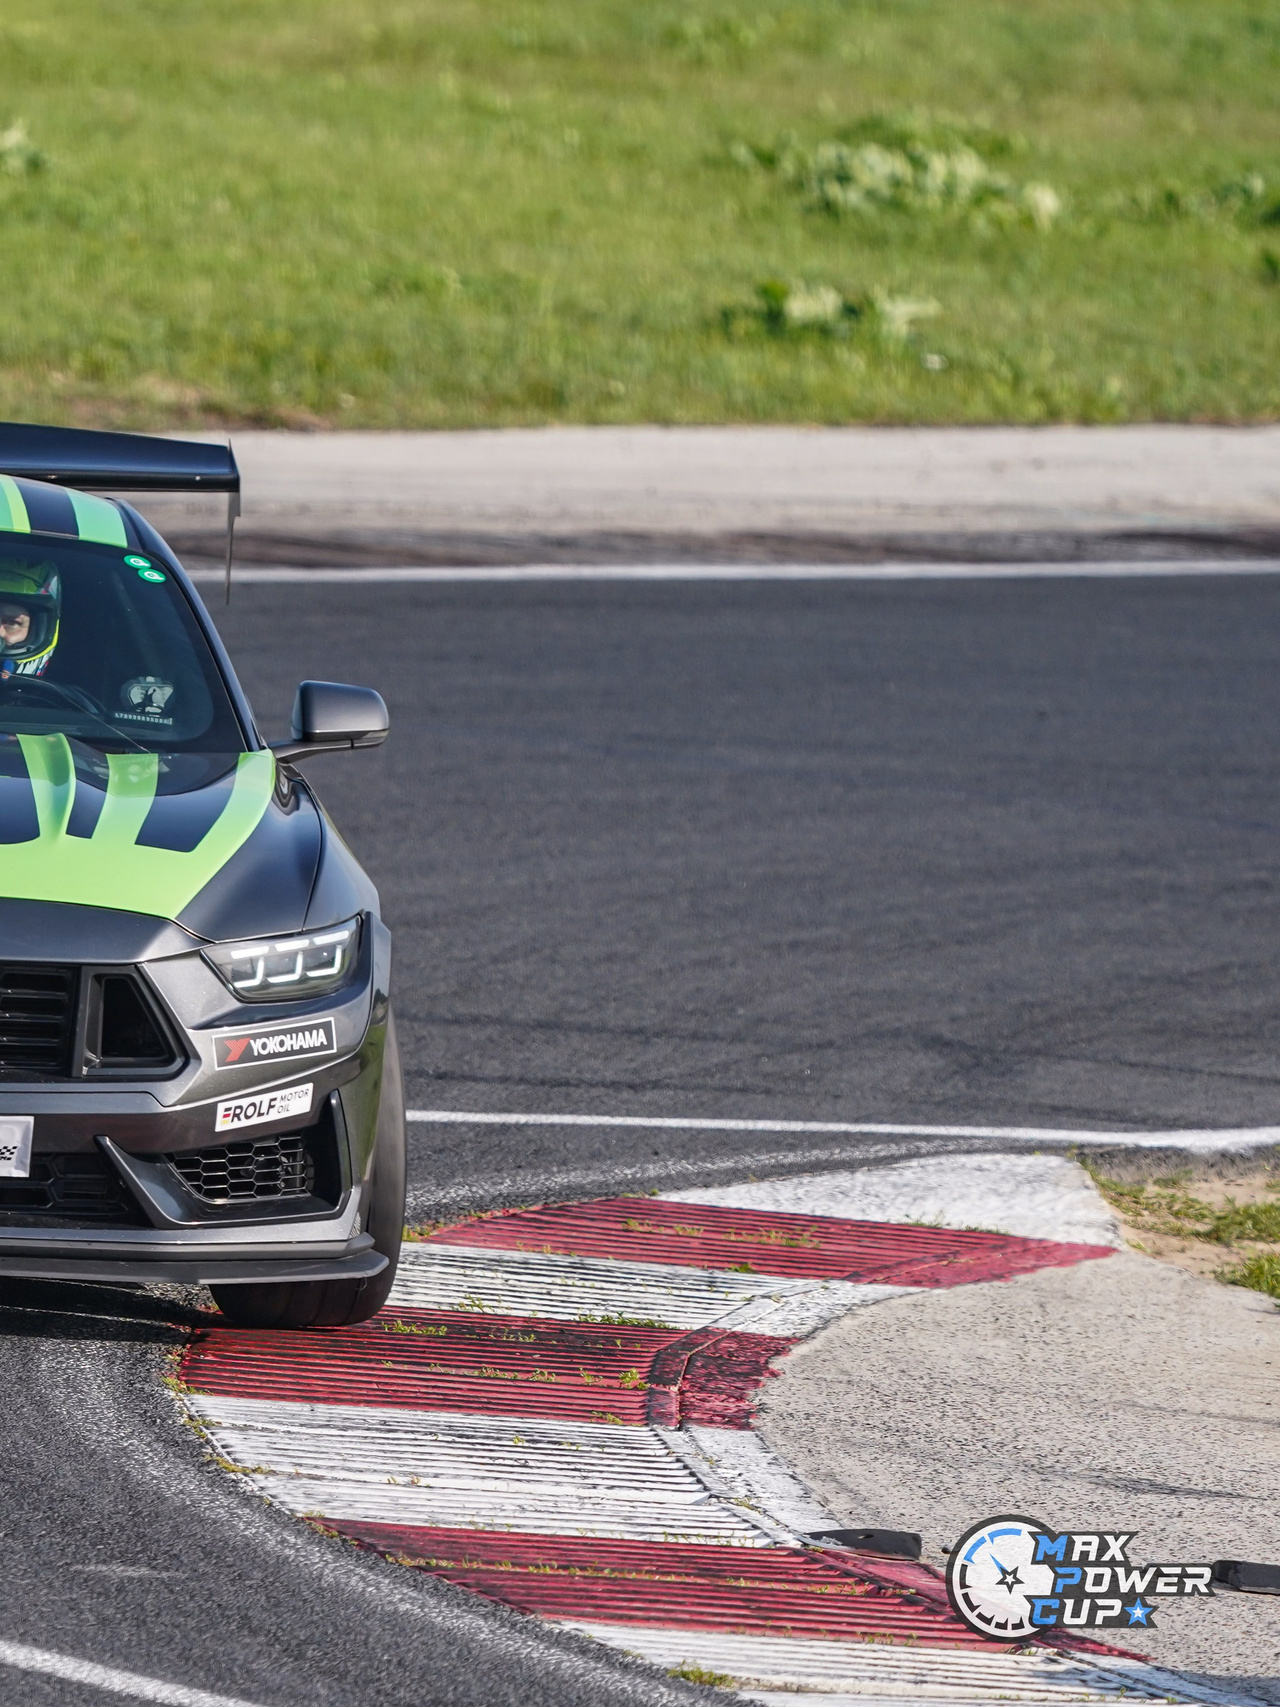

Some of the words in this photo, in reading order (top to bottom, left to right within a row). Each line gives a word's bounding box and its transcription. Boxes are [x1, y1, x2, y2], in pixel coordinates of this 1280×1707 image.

[249, 1028, 328, 1056] YOKOHAMA
[230, 1097, 278, 1123] ROLF
[279, 1088, 310, 1103] MOTOR
[277, 1105, 290, 1114] OIL
